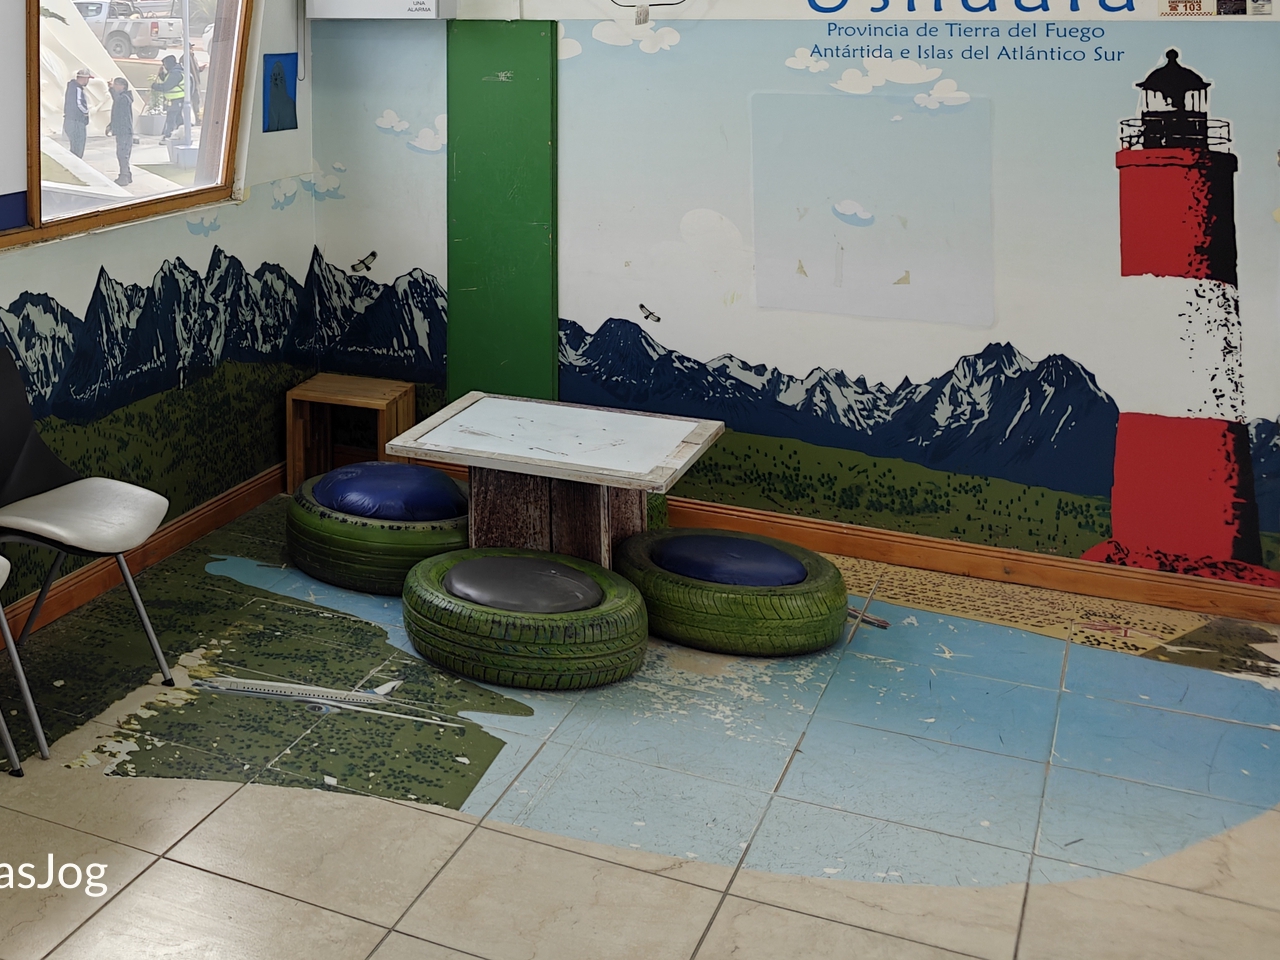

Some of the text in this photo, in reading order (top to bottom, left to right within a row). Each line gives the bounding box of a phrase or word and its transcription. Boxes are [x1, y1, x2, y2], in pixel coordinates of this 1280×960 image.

[827, 22, 1105, 42] Provincia de Tierra del Fuego
[810, 44, 1124, 61] Antártida e Islas del Atlántico Sur
